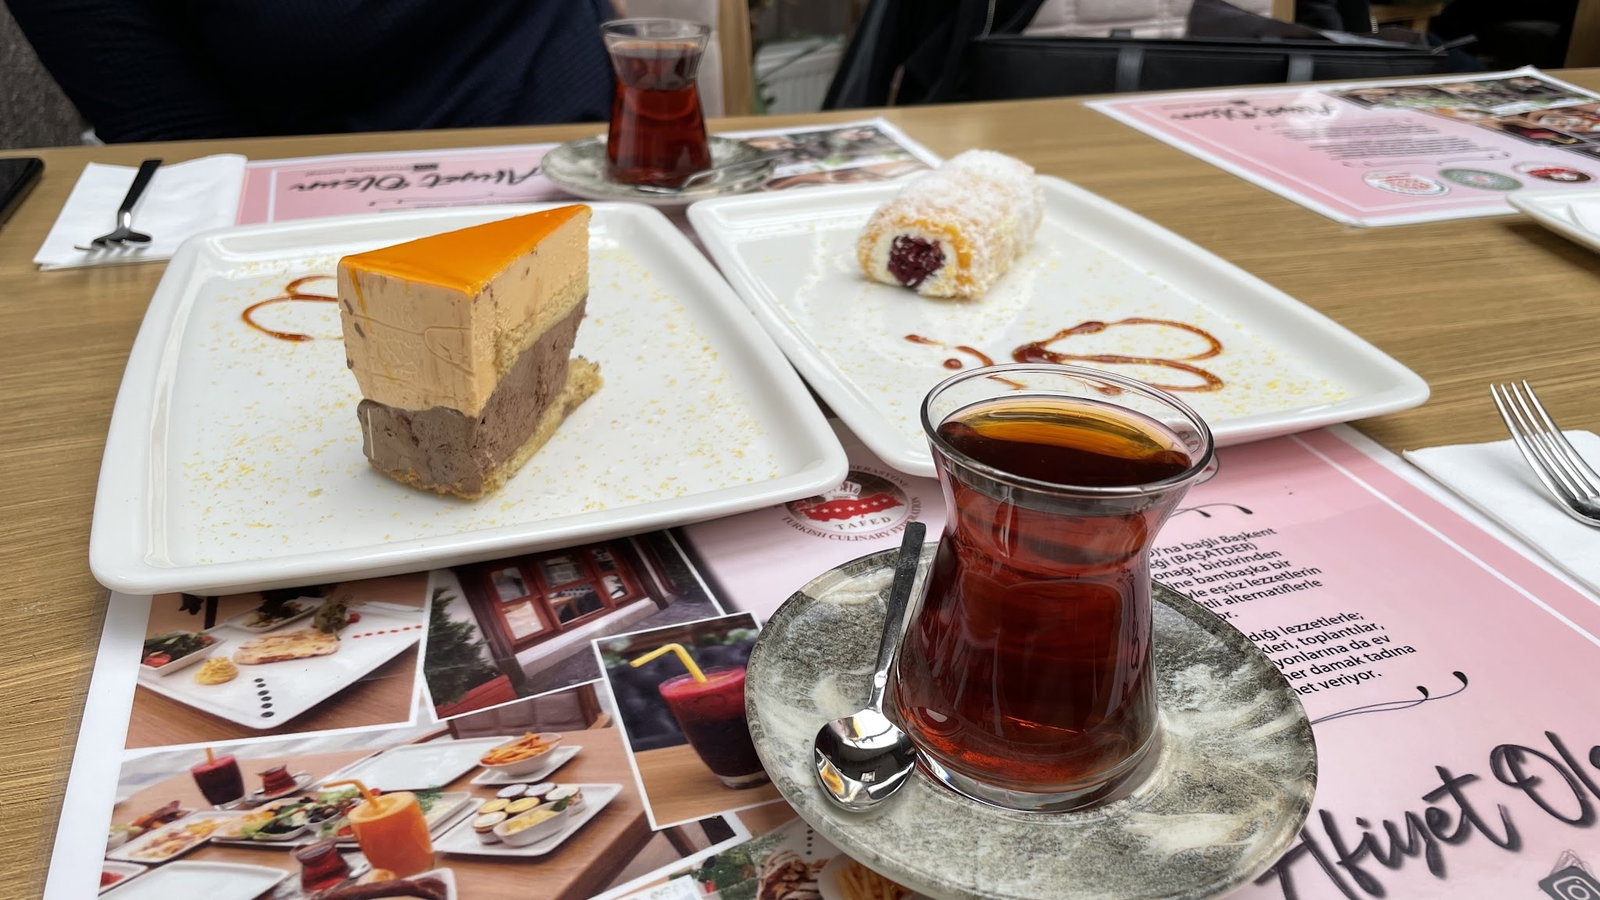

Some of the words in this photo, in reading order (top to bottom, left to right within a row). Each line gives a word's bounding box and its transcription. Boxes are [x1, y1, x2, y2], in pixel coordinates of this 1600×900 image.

[781, 516, 827, 539] TURKISH
[828, 529, 891, 542] CULINARY
[834, 516, 892, 532] TAFED
[1180, 537, 1220, 550] bağlı
[1219, 527, 1278, 543] Başkent
[1170, 541, 1258, 566] (BAŞATDER)
[1199, 550, 1282, 571] birbirinden
[1192, 565, 1270, 585] bambaşka
[1267, 559, 1292, 571] bir
[1209, 581, 1247, 595] eşsiz
[1243, 567, 1323, 588] lezzetlerin
[1222, 579, 1323, 606] alternatiflerle
[1248, 629, 1281, 642] dığı
[1278, 612, 1364, 636] lezzetlerle;
[1297, 622, 1385, 646] toplantılar,
[1272, 645, 1350, 670] yonlarına
[1348, 639, 1371, 650] da
[1371, 634, 1391, 645] ev
[1309, 655, 1367, 675] damak
[1363, 645, 1417, 662] tadına
[1317, 669, 1383, 690] veriyor.
